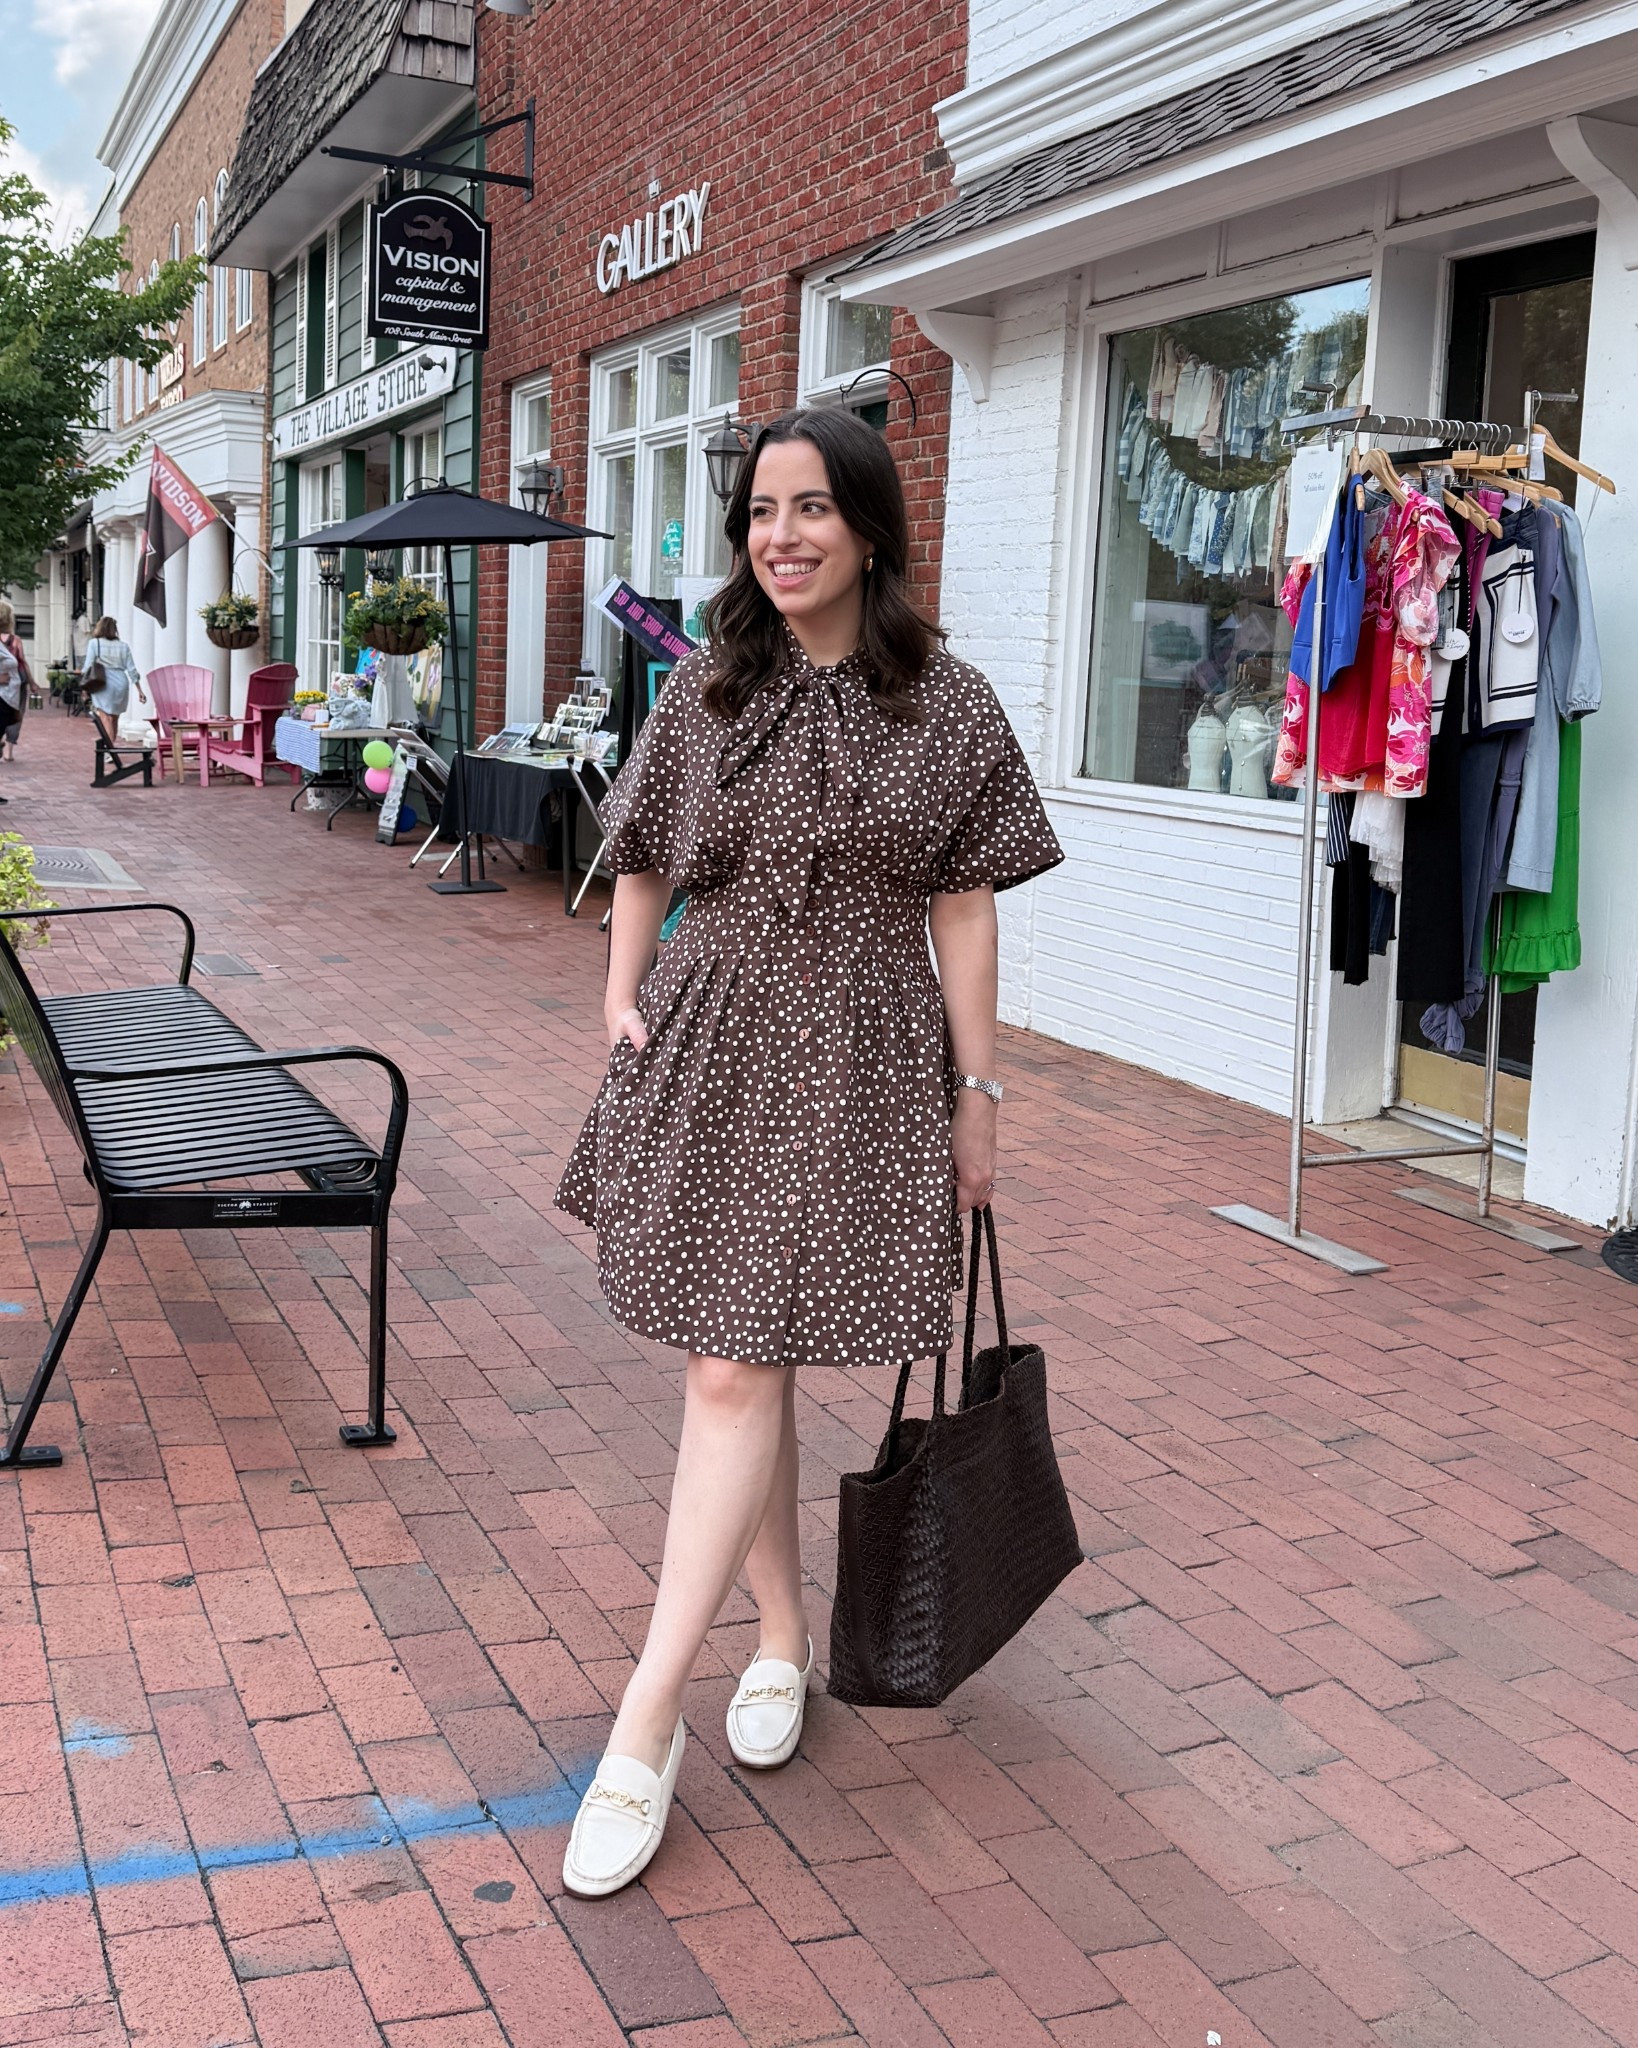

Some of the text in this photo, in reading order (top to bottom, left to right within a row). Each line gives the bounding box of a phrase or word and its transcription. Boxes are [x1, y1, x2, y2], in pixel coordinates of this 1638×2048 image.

[597, 182, 710, 293] GALLERY
[382, 244, 479, 277] VISION
[395, 276, 466, 294] capital &
[380, 293, 478, 313] management
[400, 327, 425, 338] South
[425, 331, 449, 342] Main
[448, 333, 473, 344] Street
[291, 354, 427, 447] THE VILLAGE STORE
[613, 589, 630, 607] SIP
[626, 601, 645, 621] AND
[641, 614, 664, 637] SHOP
